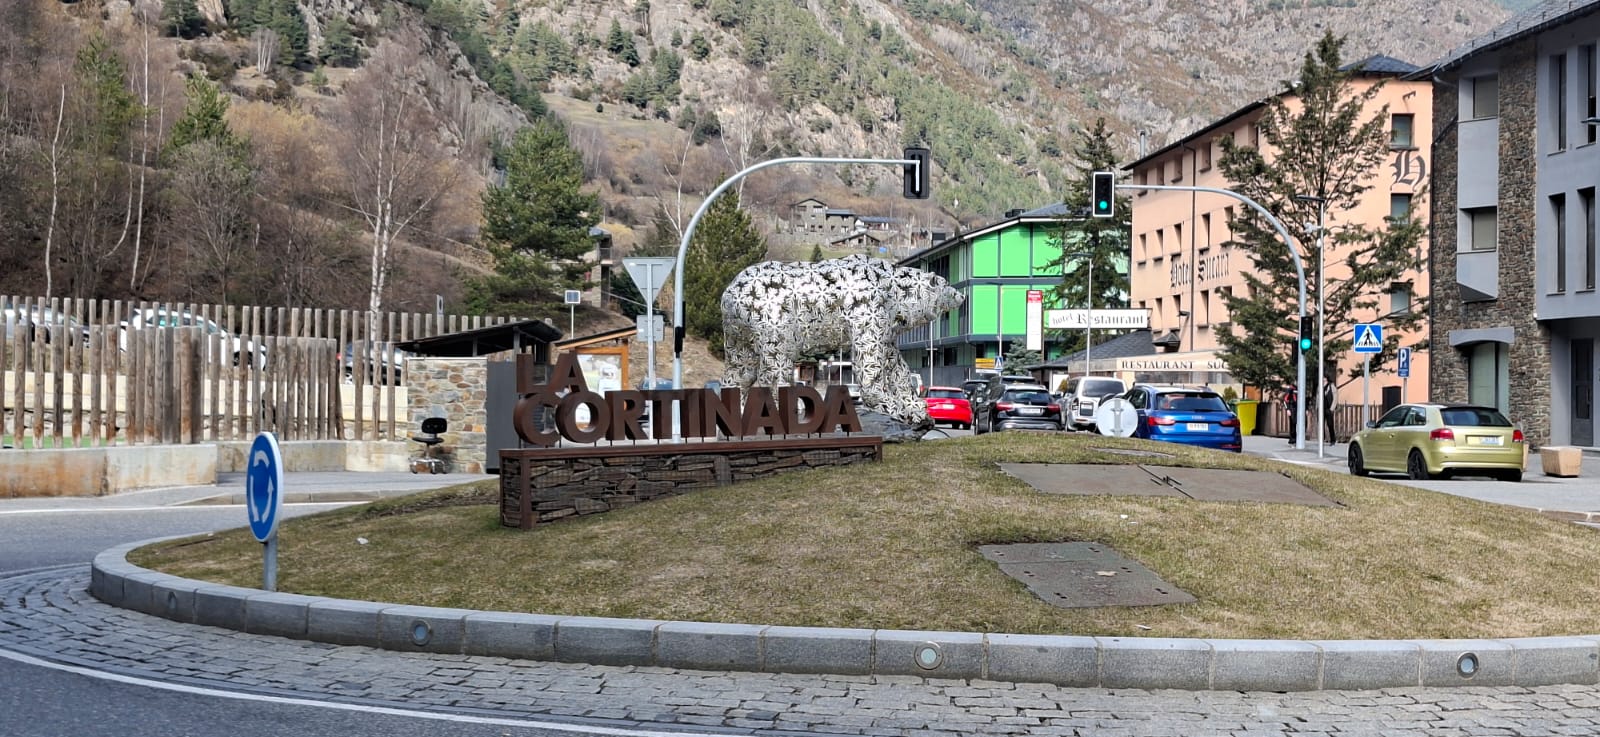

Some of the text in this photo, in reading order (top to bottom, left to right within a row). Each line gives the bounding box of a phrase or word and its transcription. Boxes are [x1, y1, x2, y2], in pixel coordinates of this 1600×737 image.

[516, 350, 589, 394] LA
[1122, 360, 1194, 369] RESTAURANT
[513, 385, 863, 446] CORTINADA
